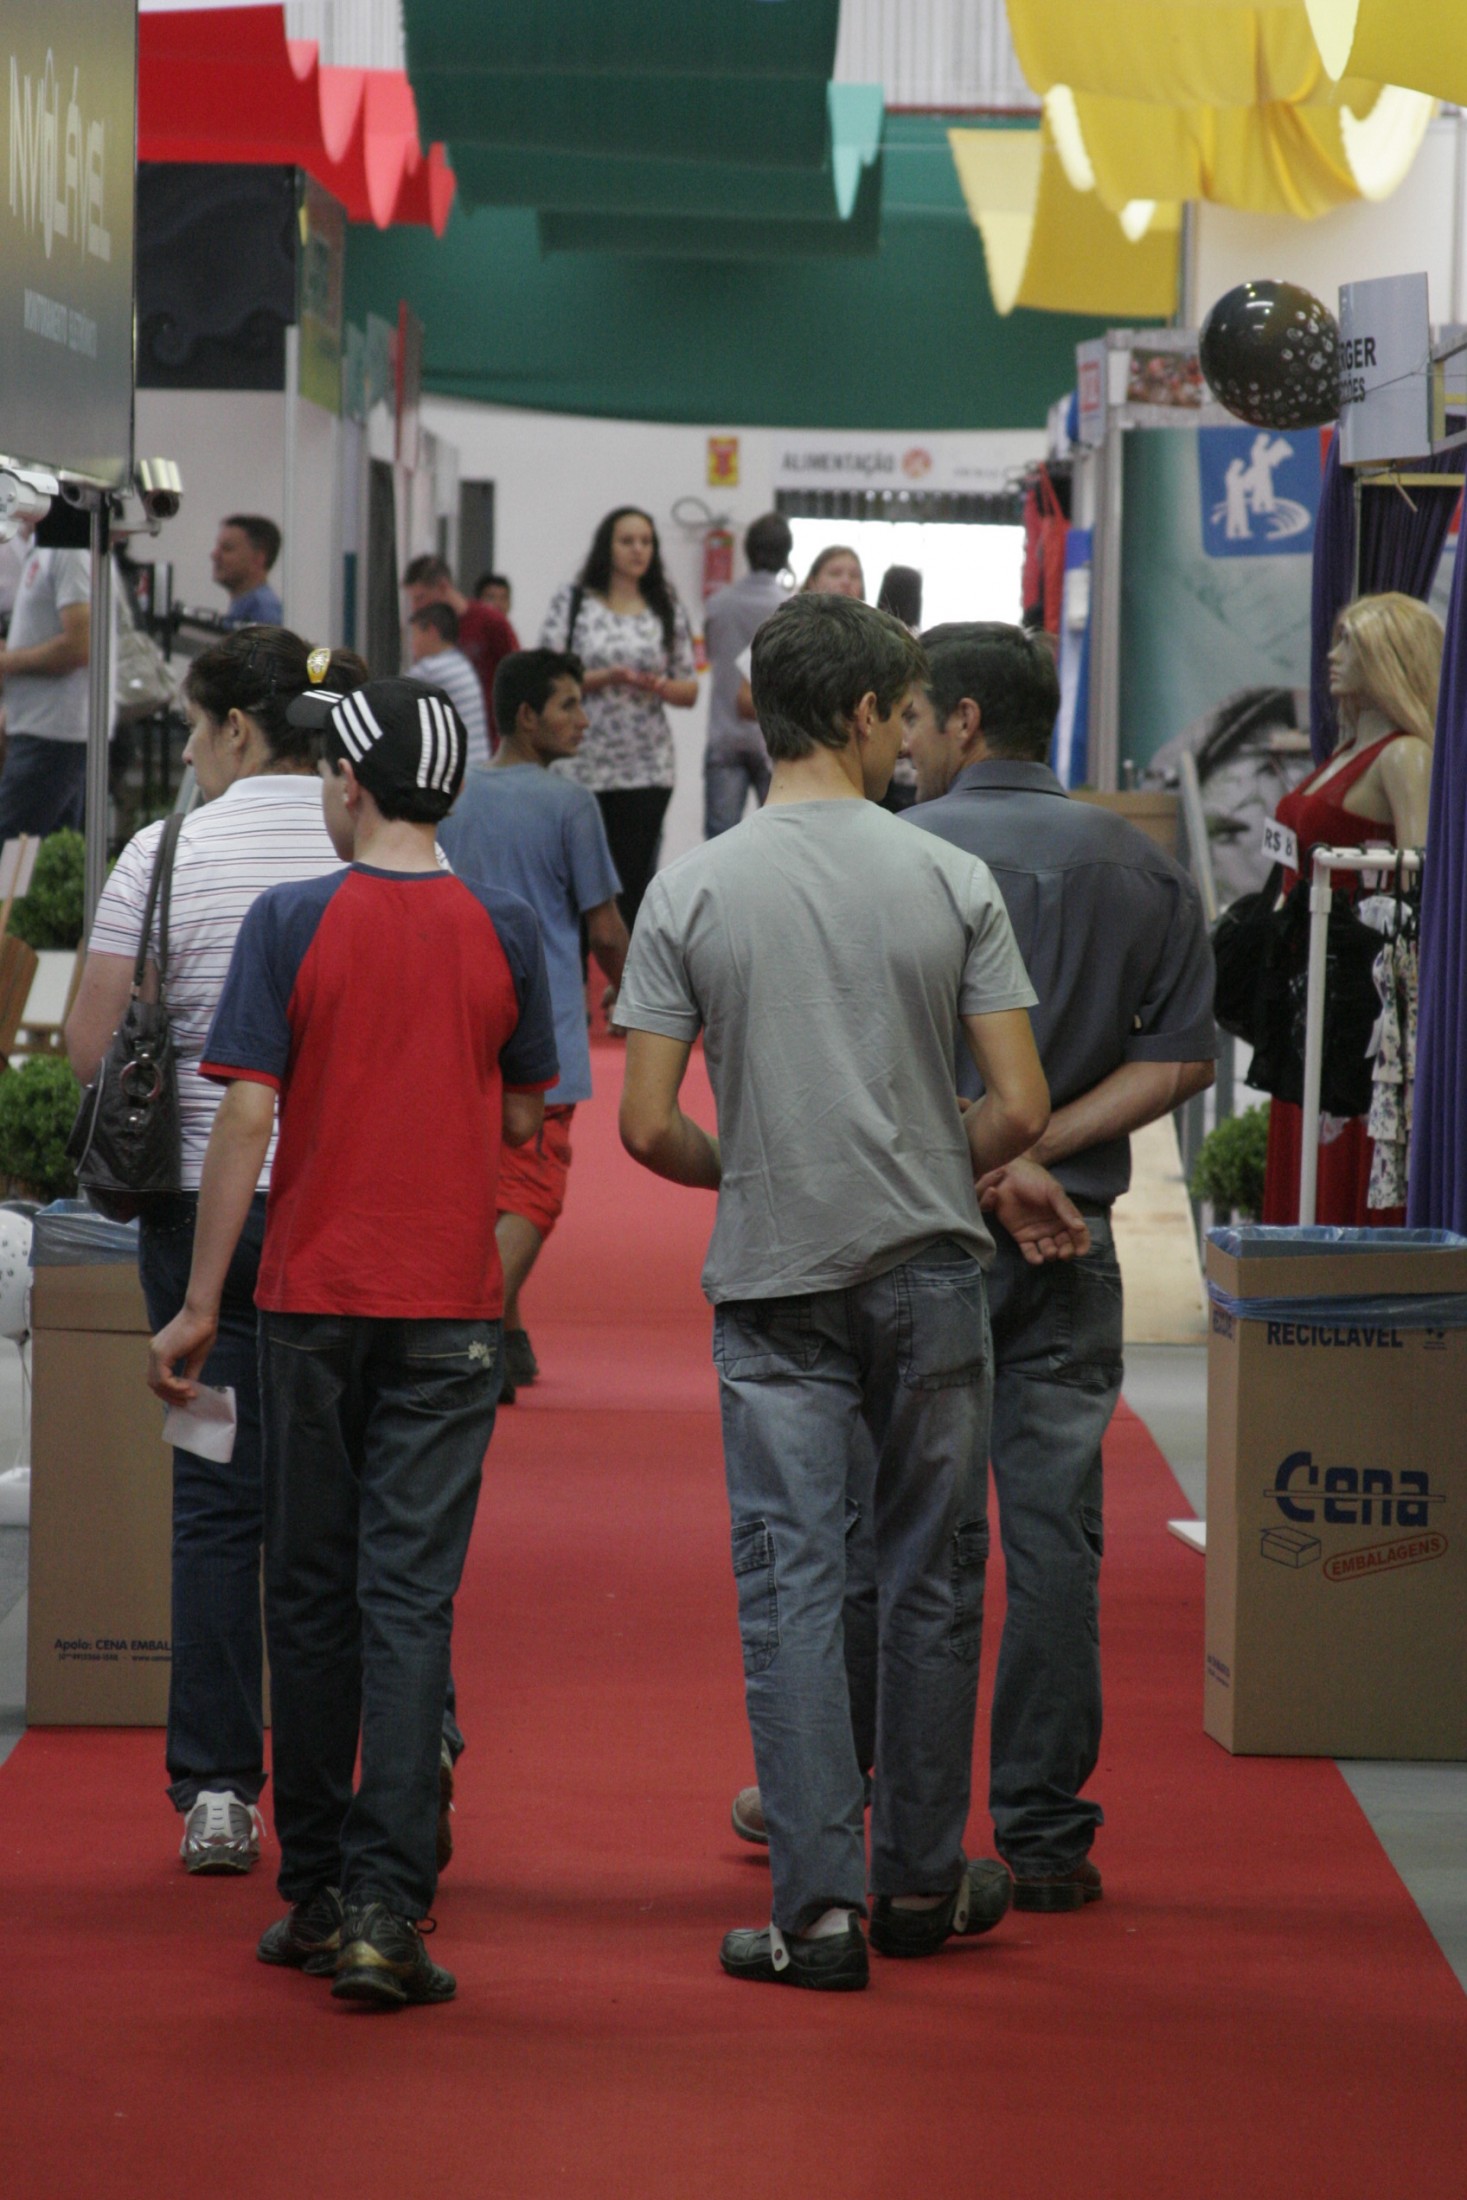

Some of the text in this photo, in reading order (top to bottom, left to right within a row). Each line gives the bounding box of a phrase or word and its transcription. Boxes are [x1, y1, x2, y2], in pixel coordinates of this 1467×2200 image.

[1275, 1450, 1429, 1527] Cena
[1331, 1537, 1441, 1576] EMBALAGENS
[95, 1639, 128, 1651] CENA
